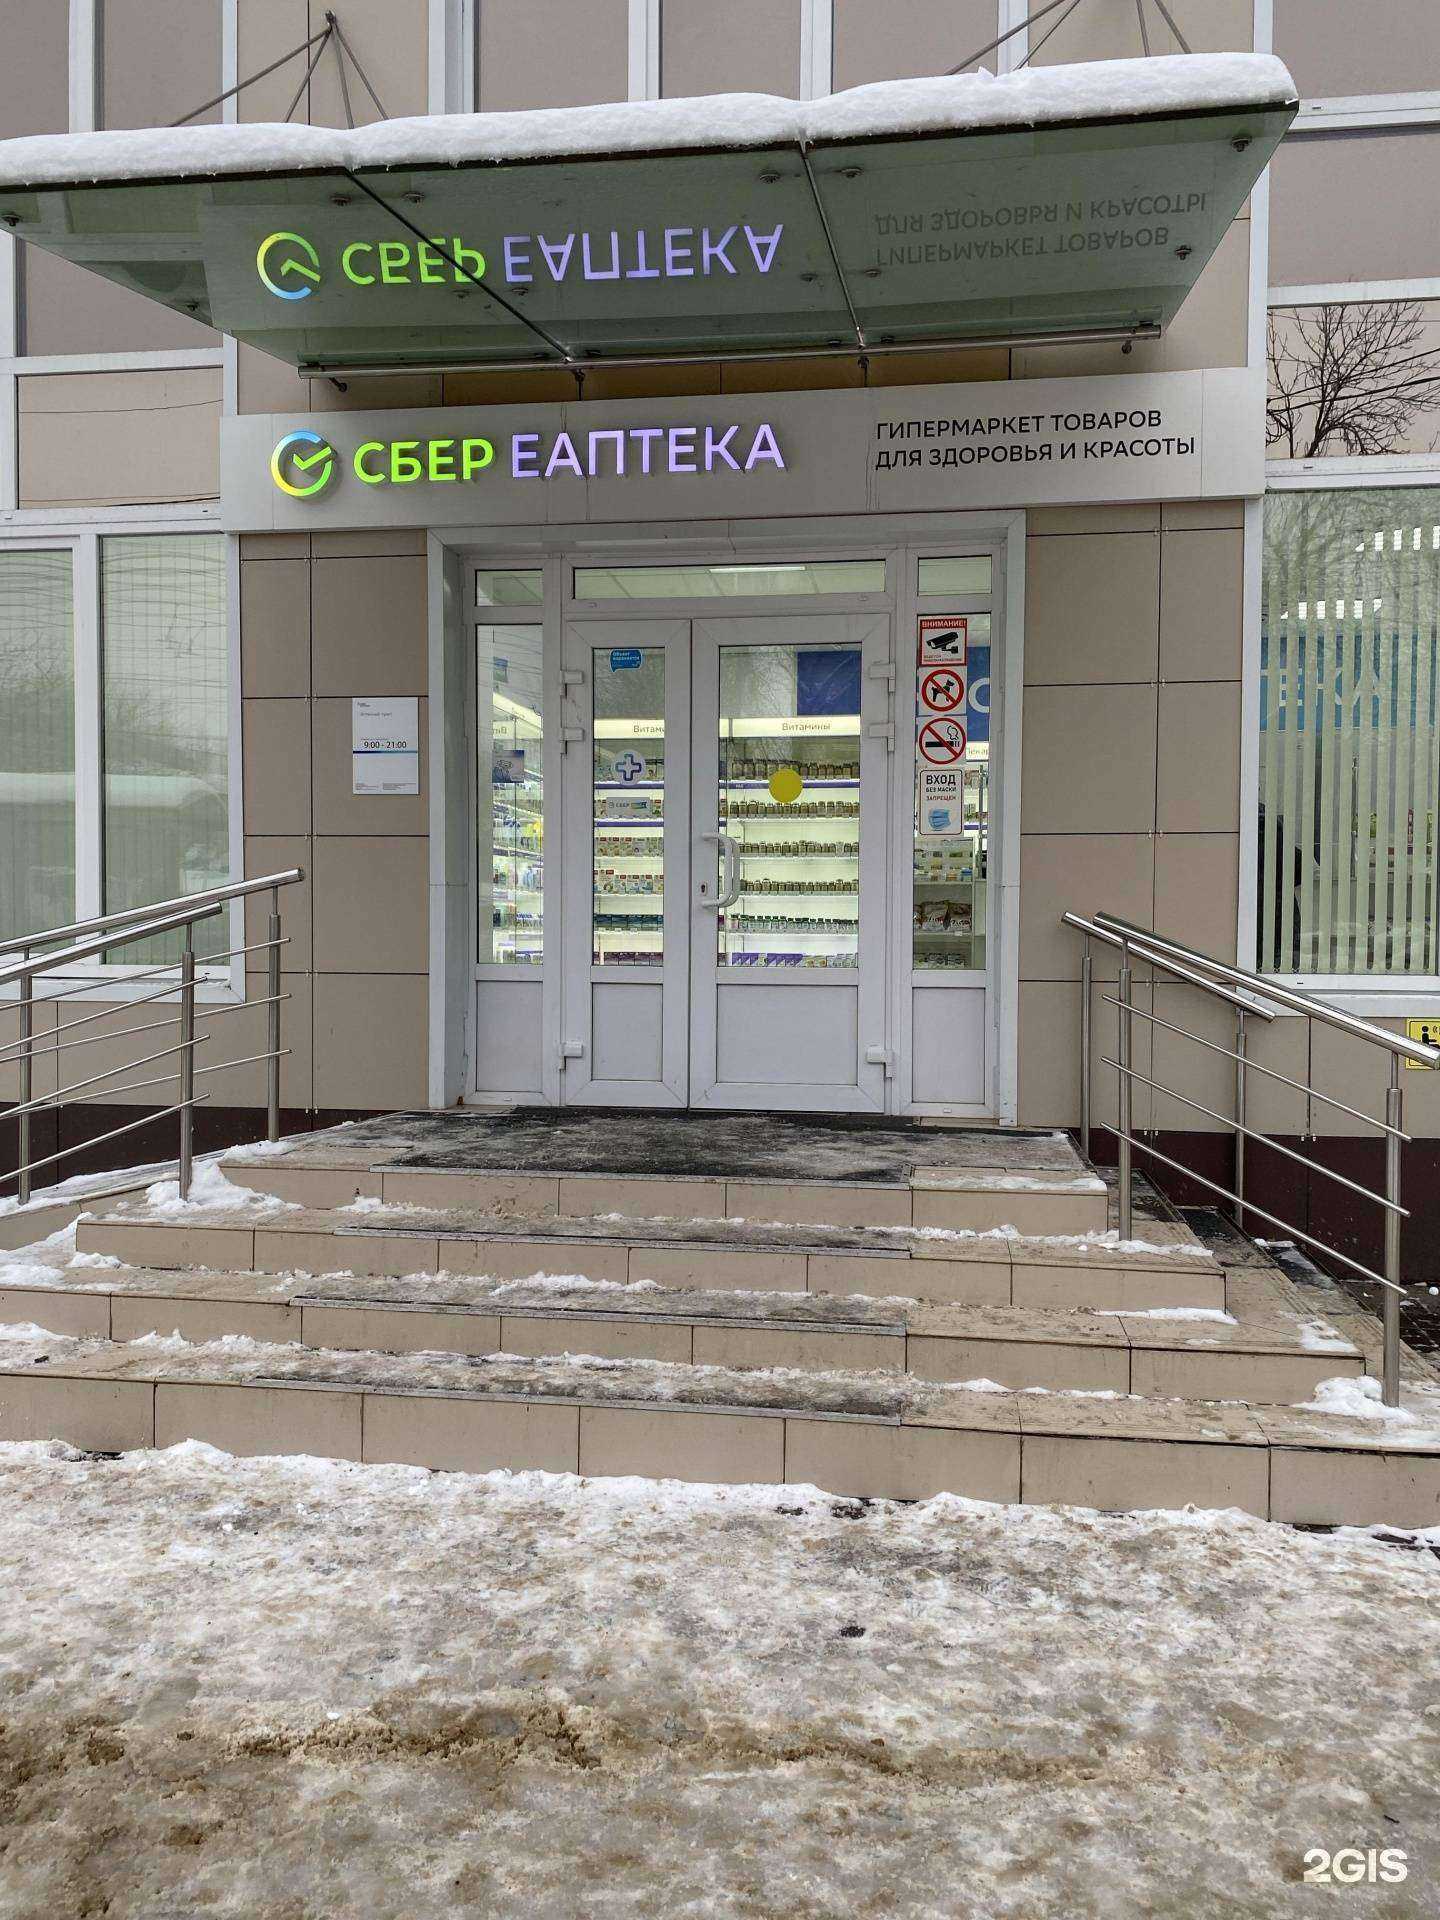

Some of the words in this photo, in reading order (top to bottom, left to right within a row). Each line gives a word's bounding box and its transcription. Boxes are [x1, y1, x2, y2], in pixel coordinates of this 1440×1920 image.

[876, 415, 1045, 440] ГИПЕРМАРКЕТ
[1050, 409, 1162, 433] ТОВАРОВ
[352, 438, 495, 484] СБЕР
[511, 423, 786, 479] ЕАПТЕКА
[875, 449, 922, 470] ДЛЯ
[928, 443, 1052, 467] ЗДОРОВЬЯ
[1060, 443, 1076, 460] И
[1083, 436, 1195, 459] КРАСОТЫ
[921, 620, 966, 628] ВНИМАНИЕ!
[781, 721, 831, 731] Витамины
[926, 774, 956, 786] ВХОД
